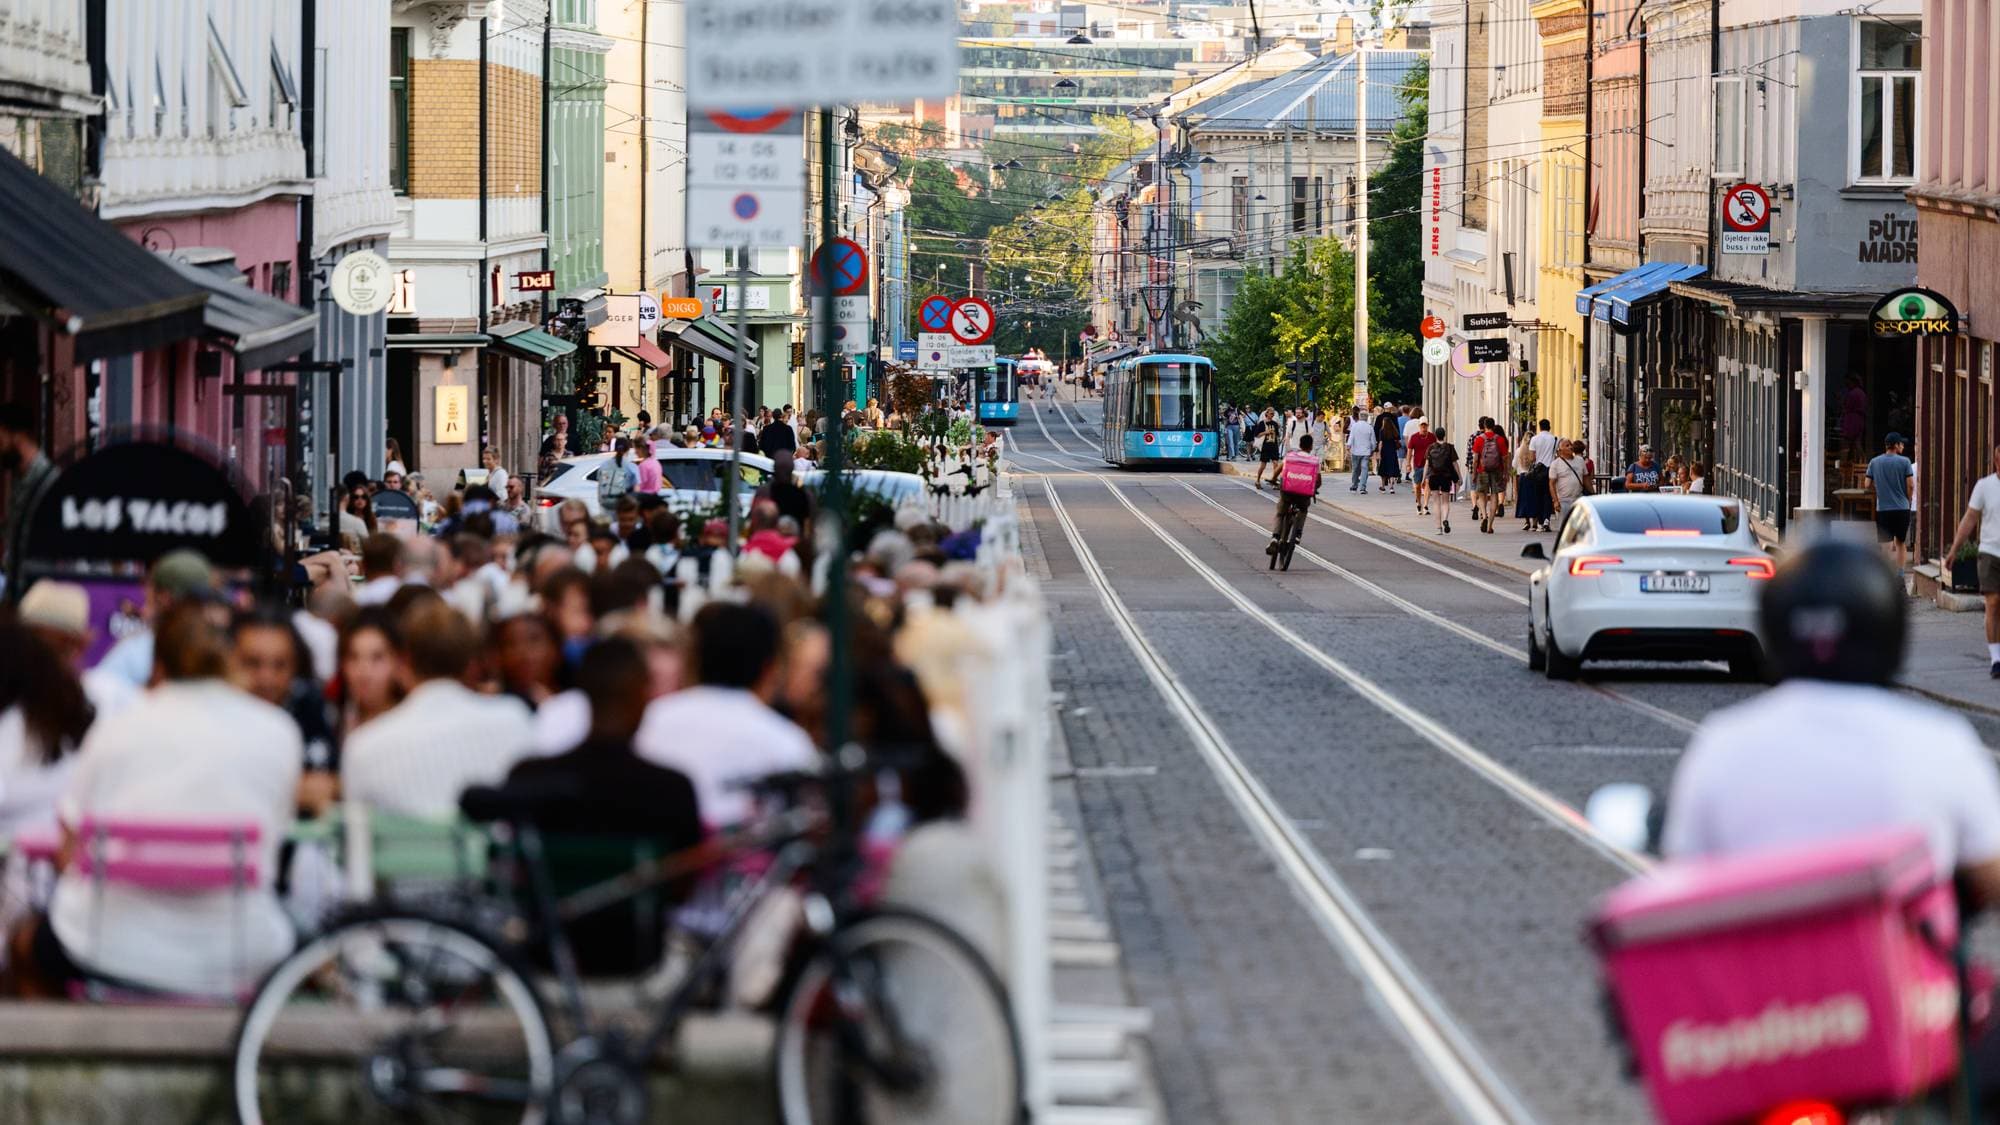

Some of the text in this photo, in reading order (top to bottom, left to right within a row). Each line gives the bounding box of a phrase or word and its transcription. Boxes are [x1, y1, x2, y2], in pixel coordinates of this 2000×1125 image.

[1725, 234, 1750, 243] Gjelder
[1726, 243, 1743, 251] buss
[1751, 243, 1766, 251] rute
[521, 273, 551, 288] Deli
[667, 303, 697, 314] DIGG
[61, 497, 228, 536] LOS TACOS
